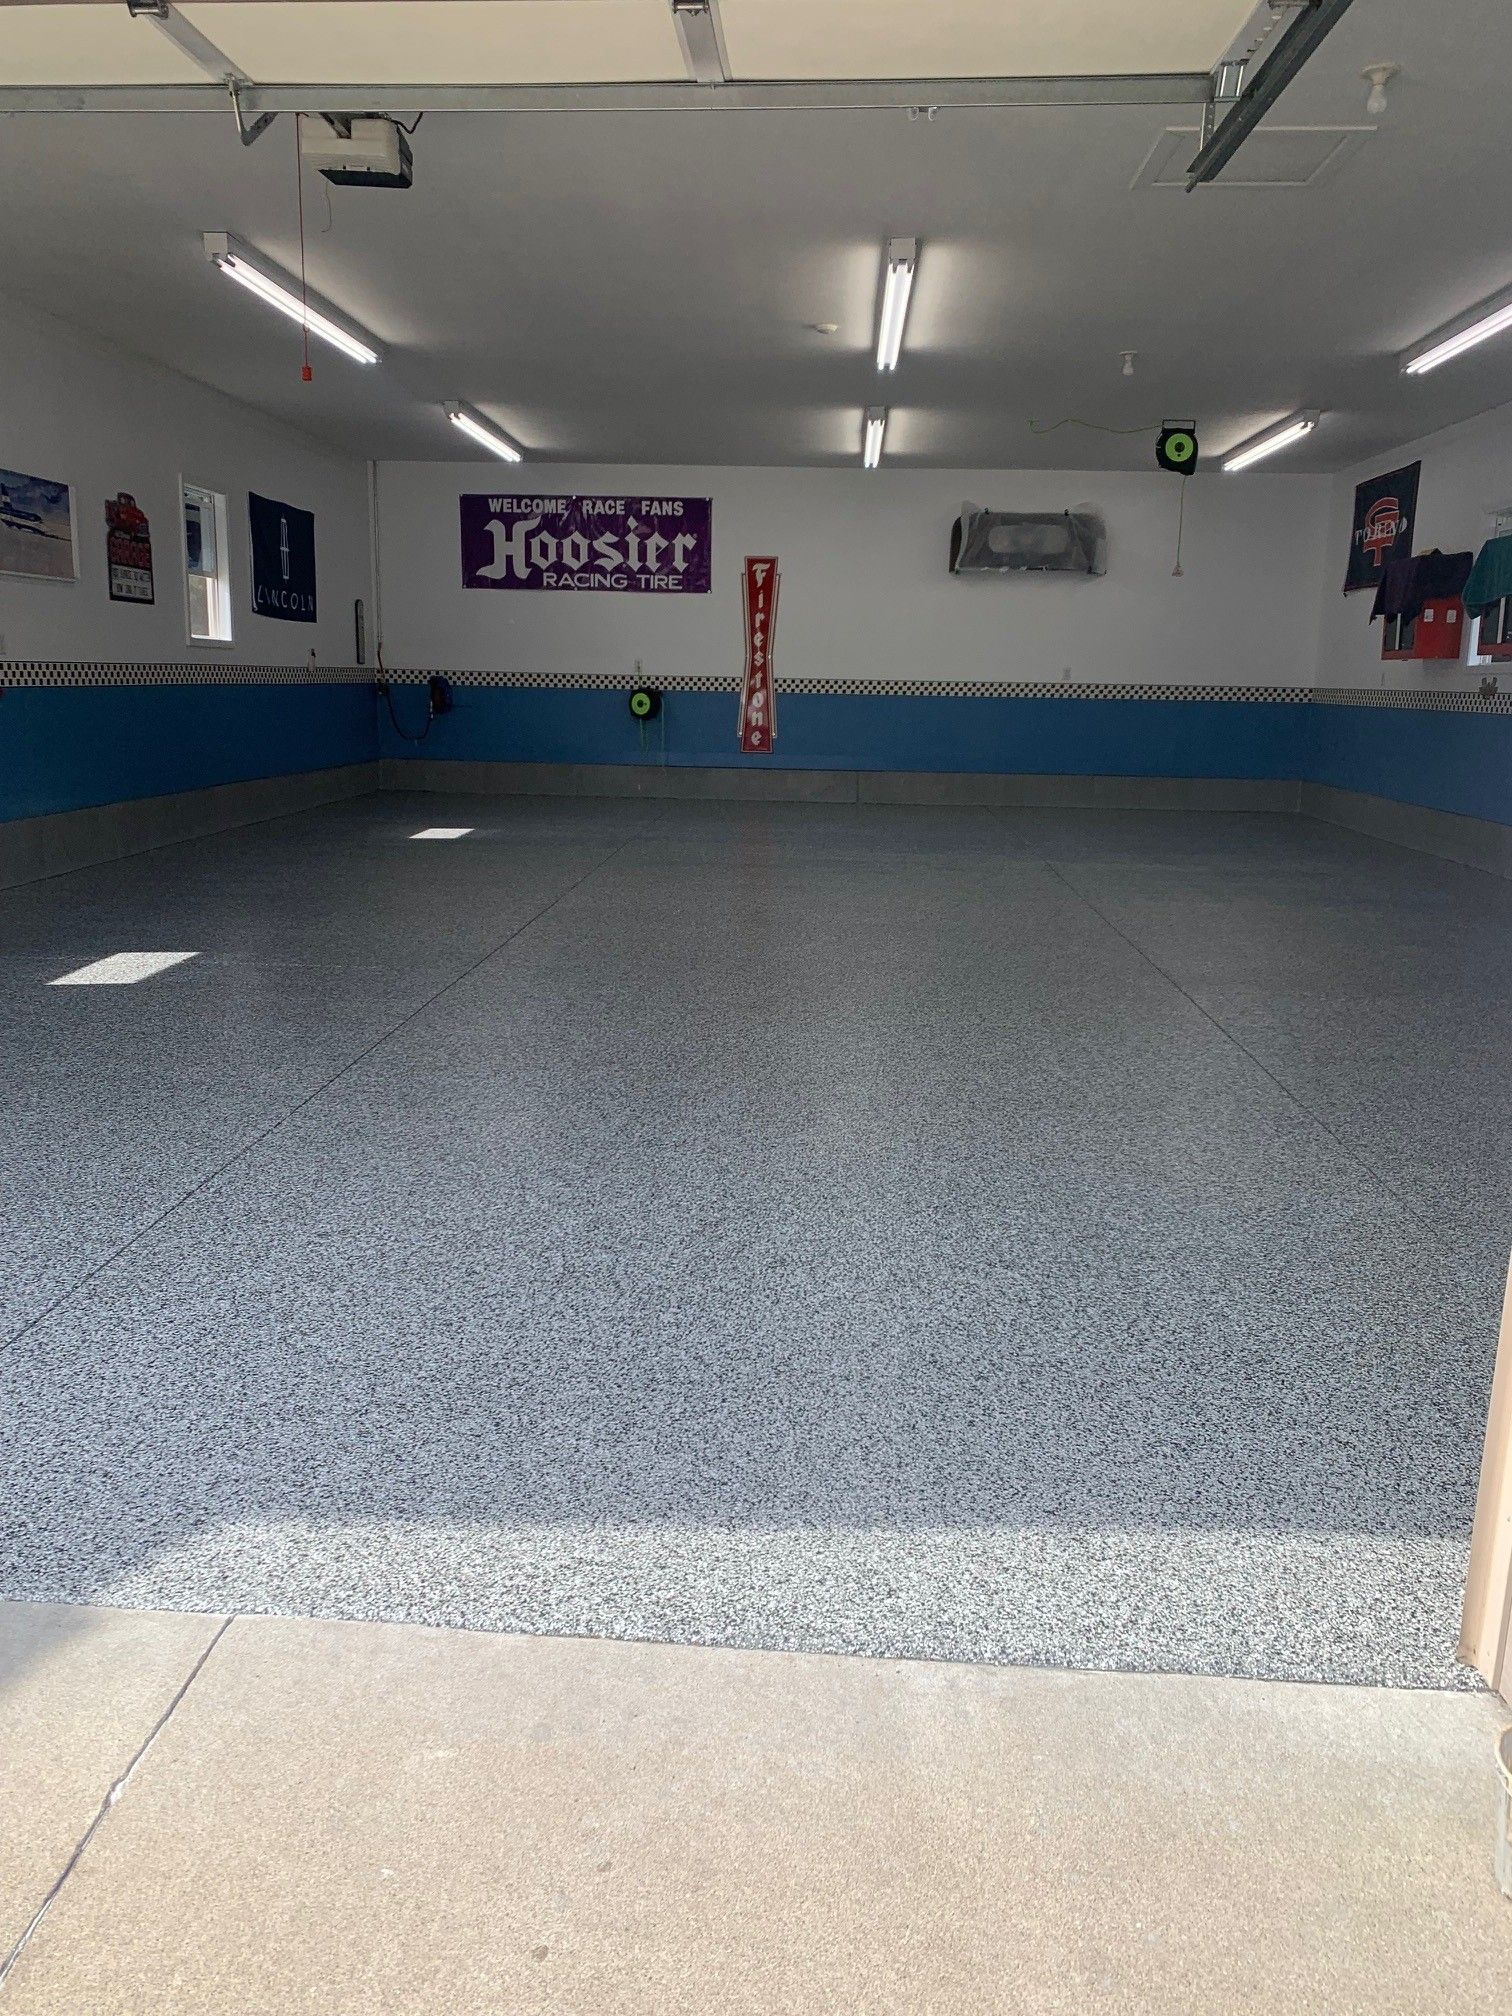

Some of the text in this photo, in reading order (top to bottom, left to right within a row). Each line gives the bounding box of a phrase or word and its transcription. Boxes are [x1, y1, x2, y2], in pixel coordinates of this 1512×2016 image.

[488, 498, 684, 517] WELCOME RACE FANS
[475, 515, 697, 580] Hoosier
[542, 572, 683, 590] RACING TIRE
[257, 584, 314, 612] LINCOLN
[751, 562, 771, 746] Firestone
